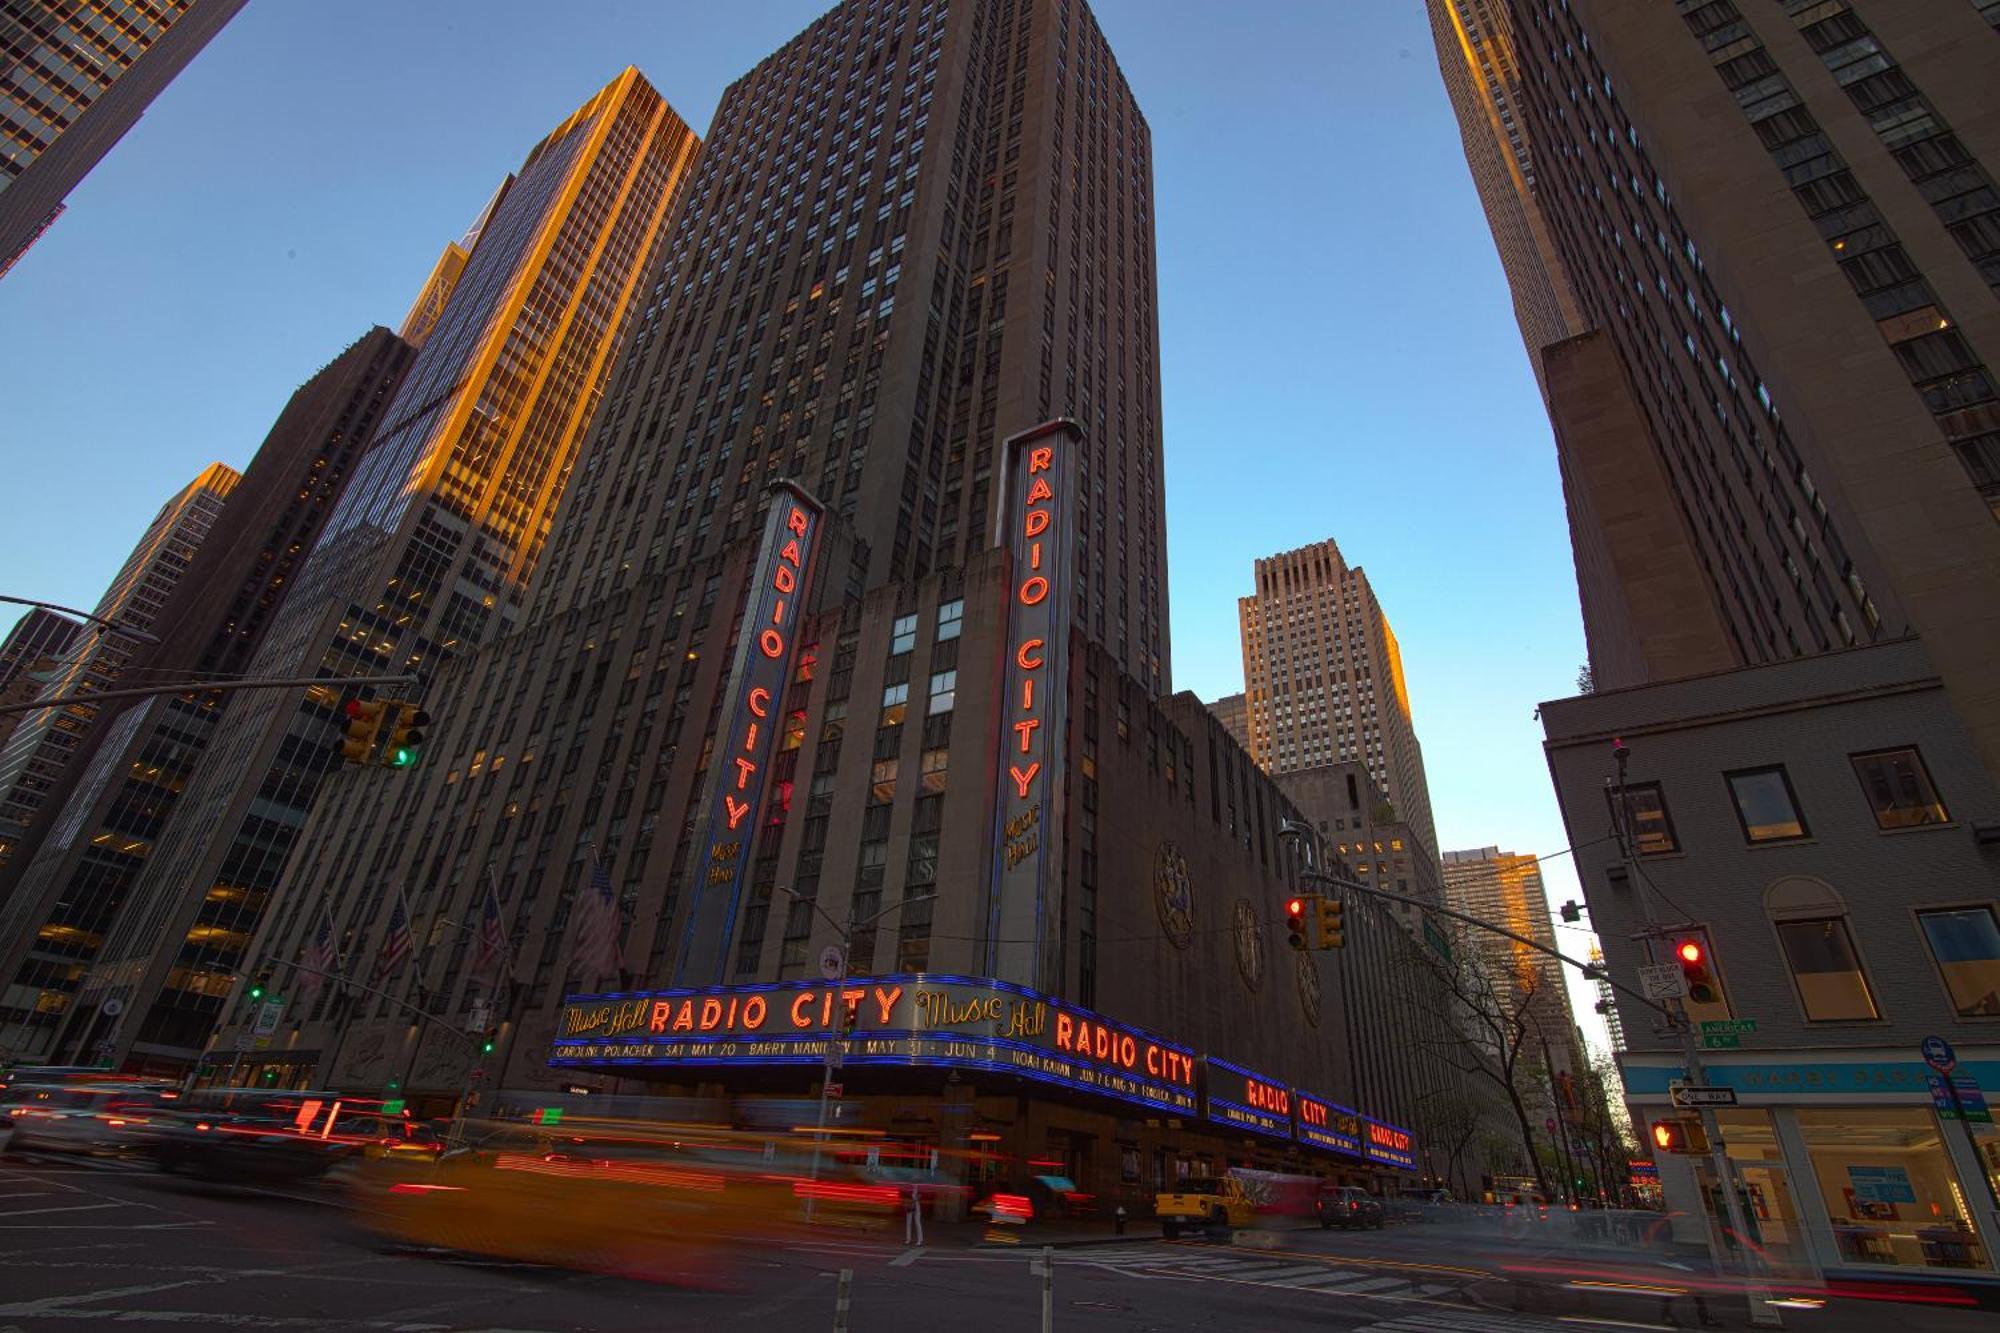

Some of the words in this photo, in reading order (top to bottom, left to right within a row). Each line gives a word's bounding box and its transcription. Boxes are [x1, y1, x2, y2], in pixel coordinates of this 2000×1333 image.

[1019, 446, 1053, 605] RADIO
[760, 506, 808, 659] RADIO
[1009, 638, 1044, 797] CITY
[725, 687, 770, 830] CITY
[567, 1007, 609, 1036] Music
[603, 999, 649, 1036] Hall
[650, 995, 767, 1033] RADIO
[790, 986, 902, 1028] CITY
[915, 990, 1002, 1029] Music
[996, 999, 1047, 1038] Hall
[557, 1045, 598, 1057] CAROLINE
[665, 1044, 684, 1056] SAT
[691, 1044, 714, 1056] MAY
[720, 1043, 736, 1056] 20
[749, 1043, 786, 1056] BARRY
[867, 1041, 896, 1054] MAY
[945, 1041, 976, 1058] JUN
[986, 1044, 995, 1059] 4
[1055, 1012, 1136, 1068] RADIO
[1146, 1045, 1193, 1085] CITY
[1247, 1079, 1289, 1114] RADIO
[1300, 1099, 1327, 1128] CITY
[1682, 1092, 1697, 1101] ONE
[1707, 1091, 1728, 1100] WAY
